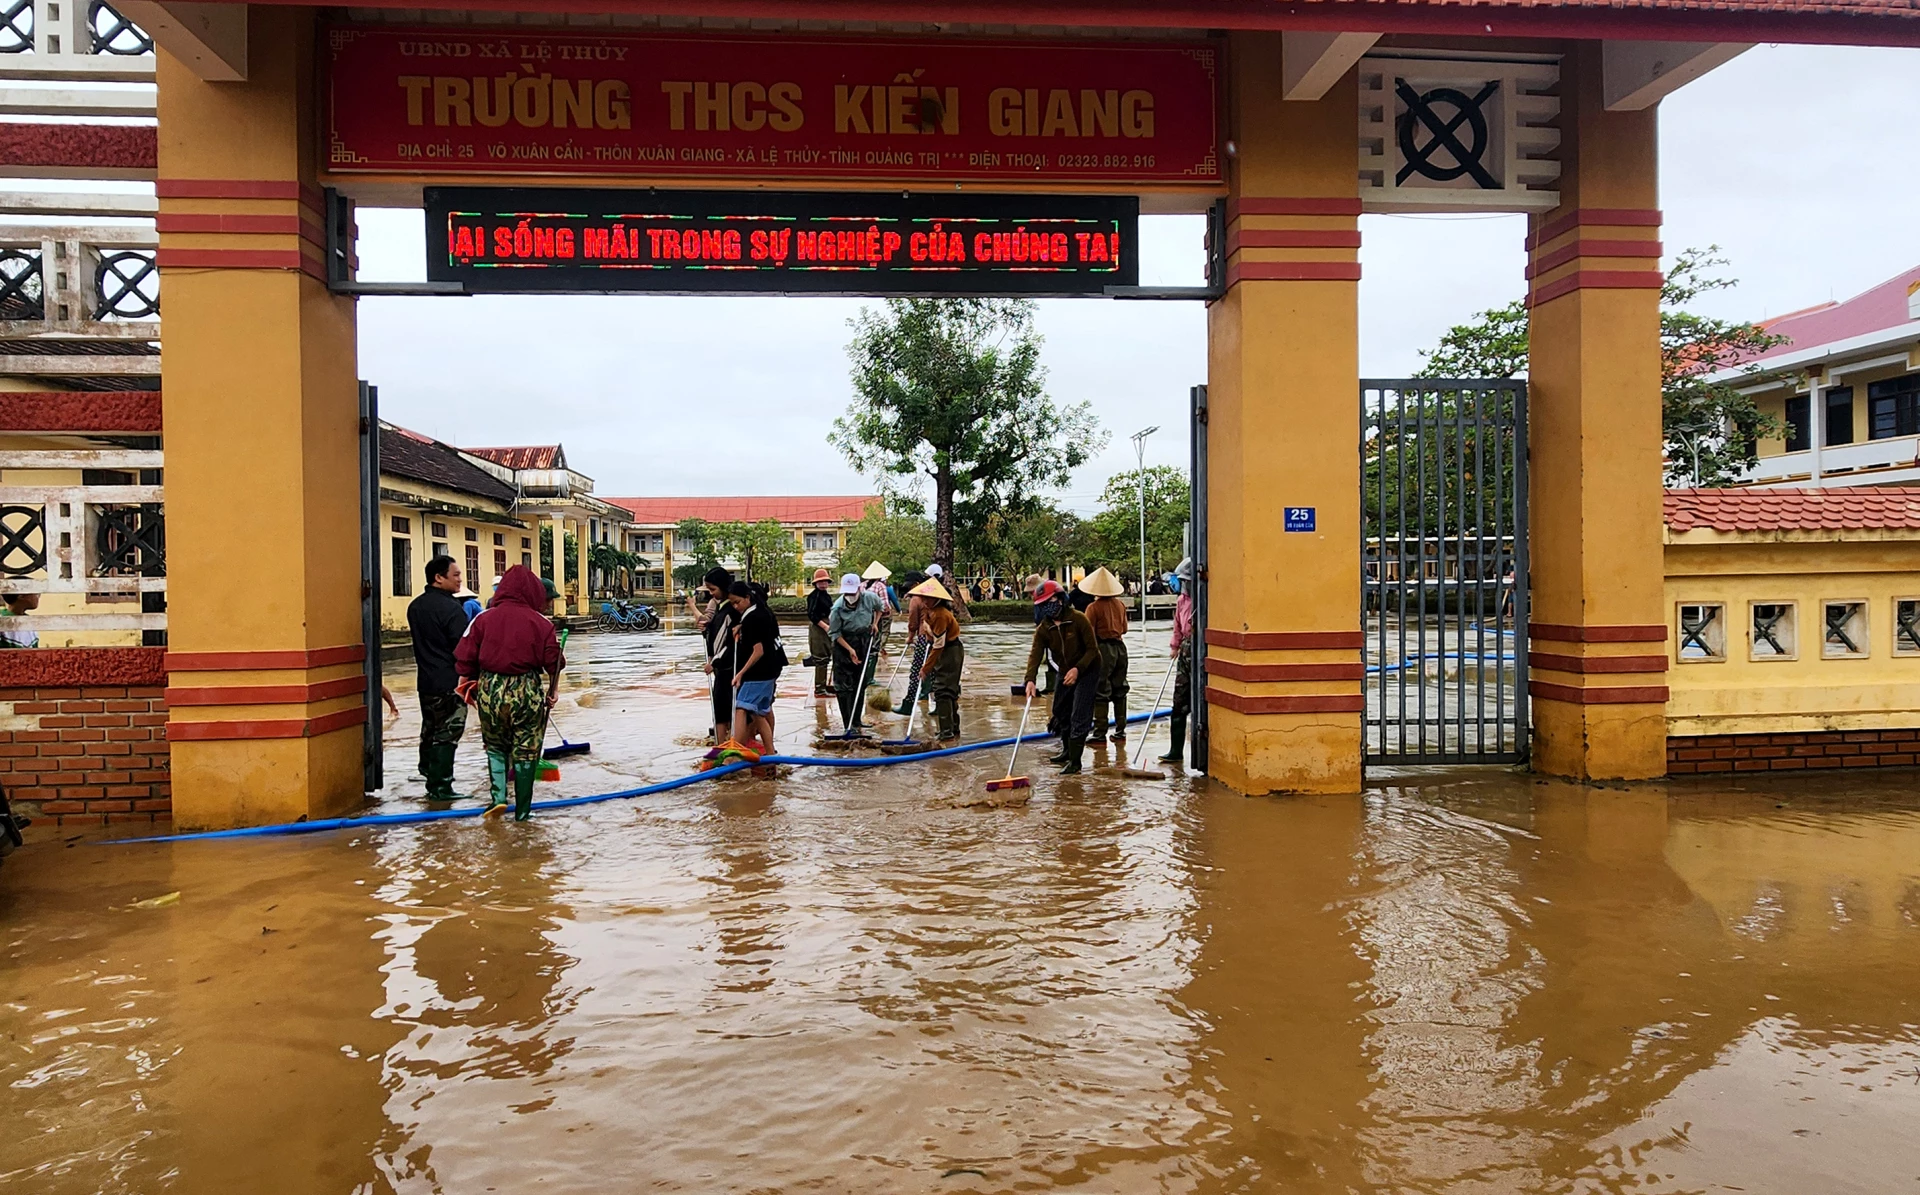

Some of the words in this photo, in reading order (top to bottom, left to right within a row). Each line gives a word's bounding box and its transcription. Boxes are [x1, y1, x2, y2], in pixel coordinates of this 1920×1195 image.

[399, 41, 471, 57] UBND
[477, 40, 513, 58] XÃ
[520, 41, 552, 63] LỆ
[557, 41, 629, 61] THỦY
[398, 63, 631, 130] TRƯỜNG
[661, 80, 805, 132] THCS
[834, 68, 960, 135] KIẾN
[988, 87, 1155, 139] GIANG
[397, 143, 421, 161] ĐỊA
[458, 144, 474, 158] 25
[488, 143, 507, 158] VÕ
[511, 143, 549, 160] XUÂN
[554, 139, 583, 160] CẨN
[594, 144, 632, 161] THÔN
[637, 144, 675, 161] XUÂN
[680, 147, 724, 162] GIANG
[736, 146, 755, 162] XÃ
[761, 145, 778, 167] LỆ
[865, 147, 914, 166] QUẢNG
[918, 152, 940, 169] TRỊ
[969, 150, 1001, 170] ĐIỆN
[1058, 154, 1155, 168] 02323.882.916
[493, 218, 574, 259] SỐNG
[584, 223, 639, 260] MÃI
[647, 228, 742, 260] TRONG
[750, 227, 791, 267] SỰ
[797, 225, 901, 267] NGHIỆP
[910, 223, 966, 262] CỦA
[973, 226, 1068, 262] CHÚNG
[1075, 232, 1119, 263] TA!
[1291, 509, 1309, 521] 25
